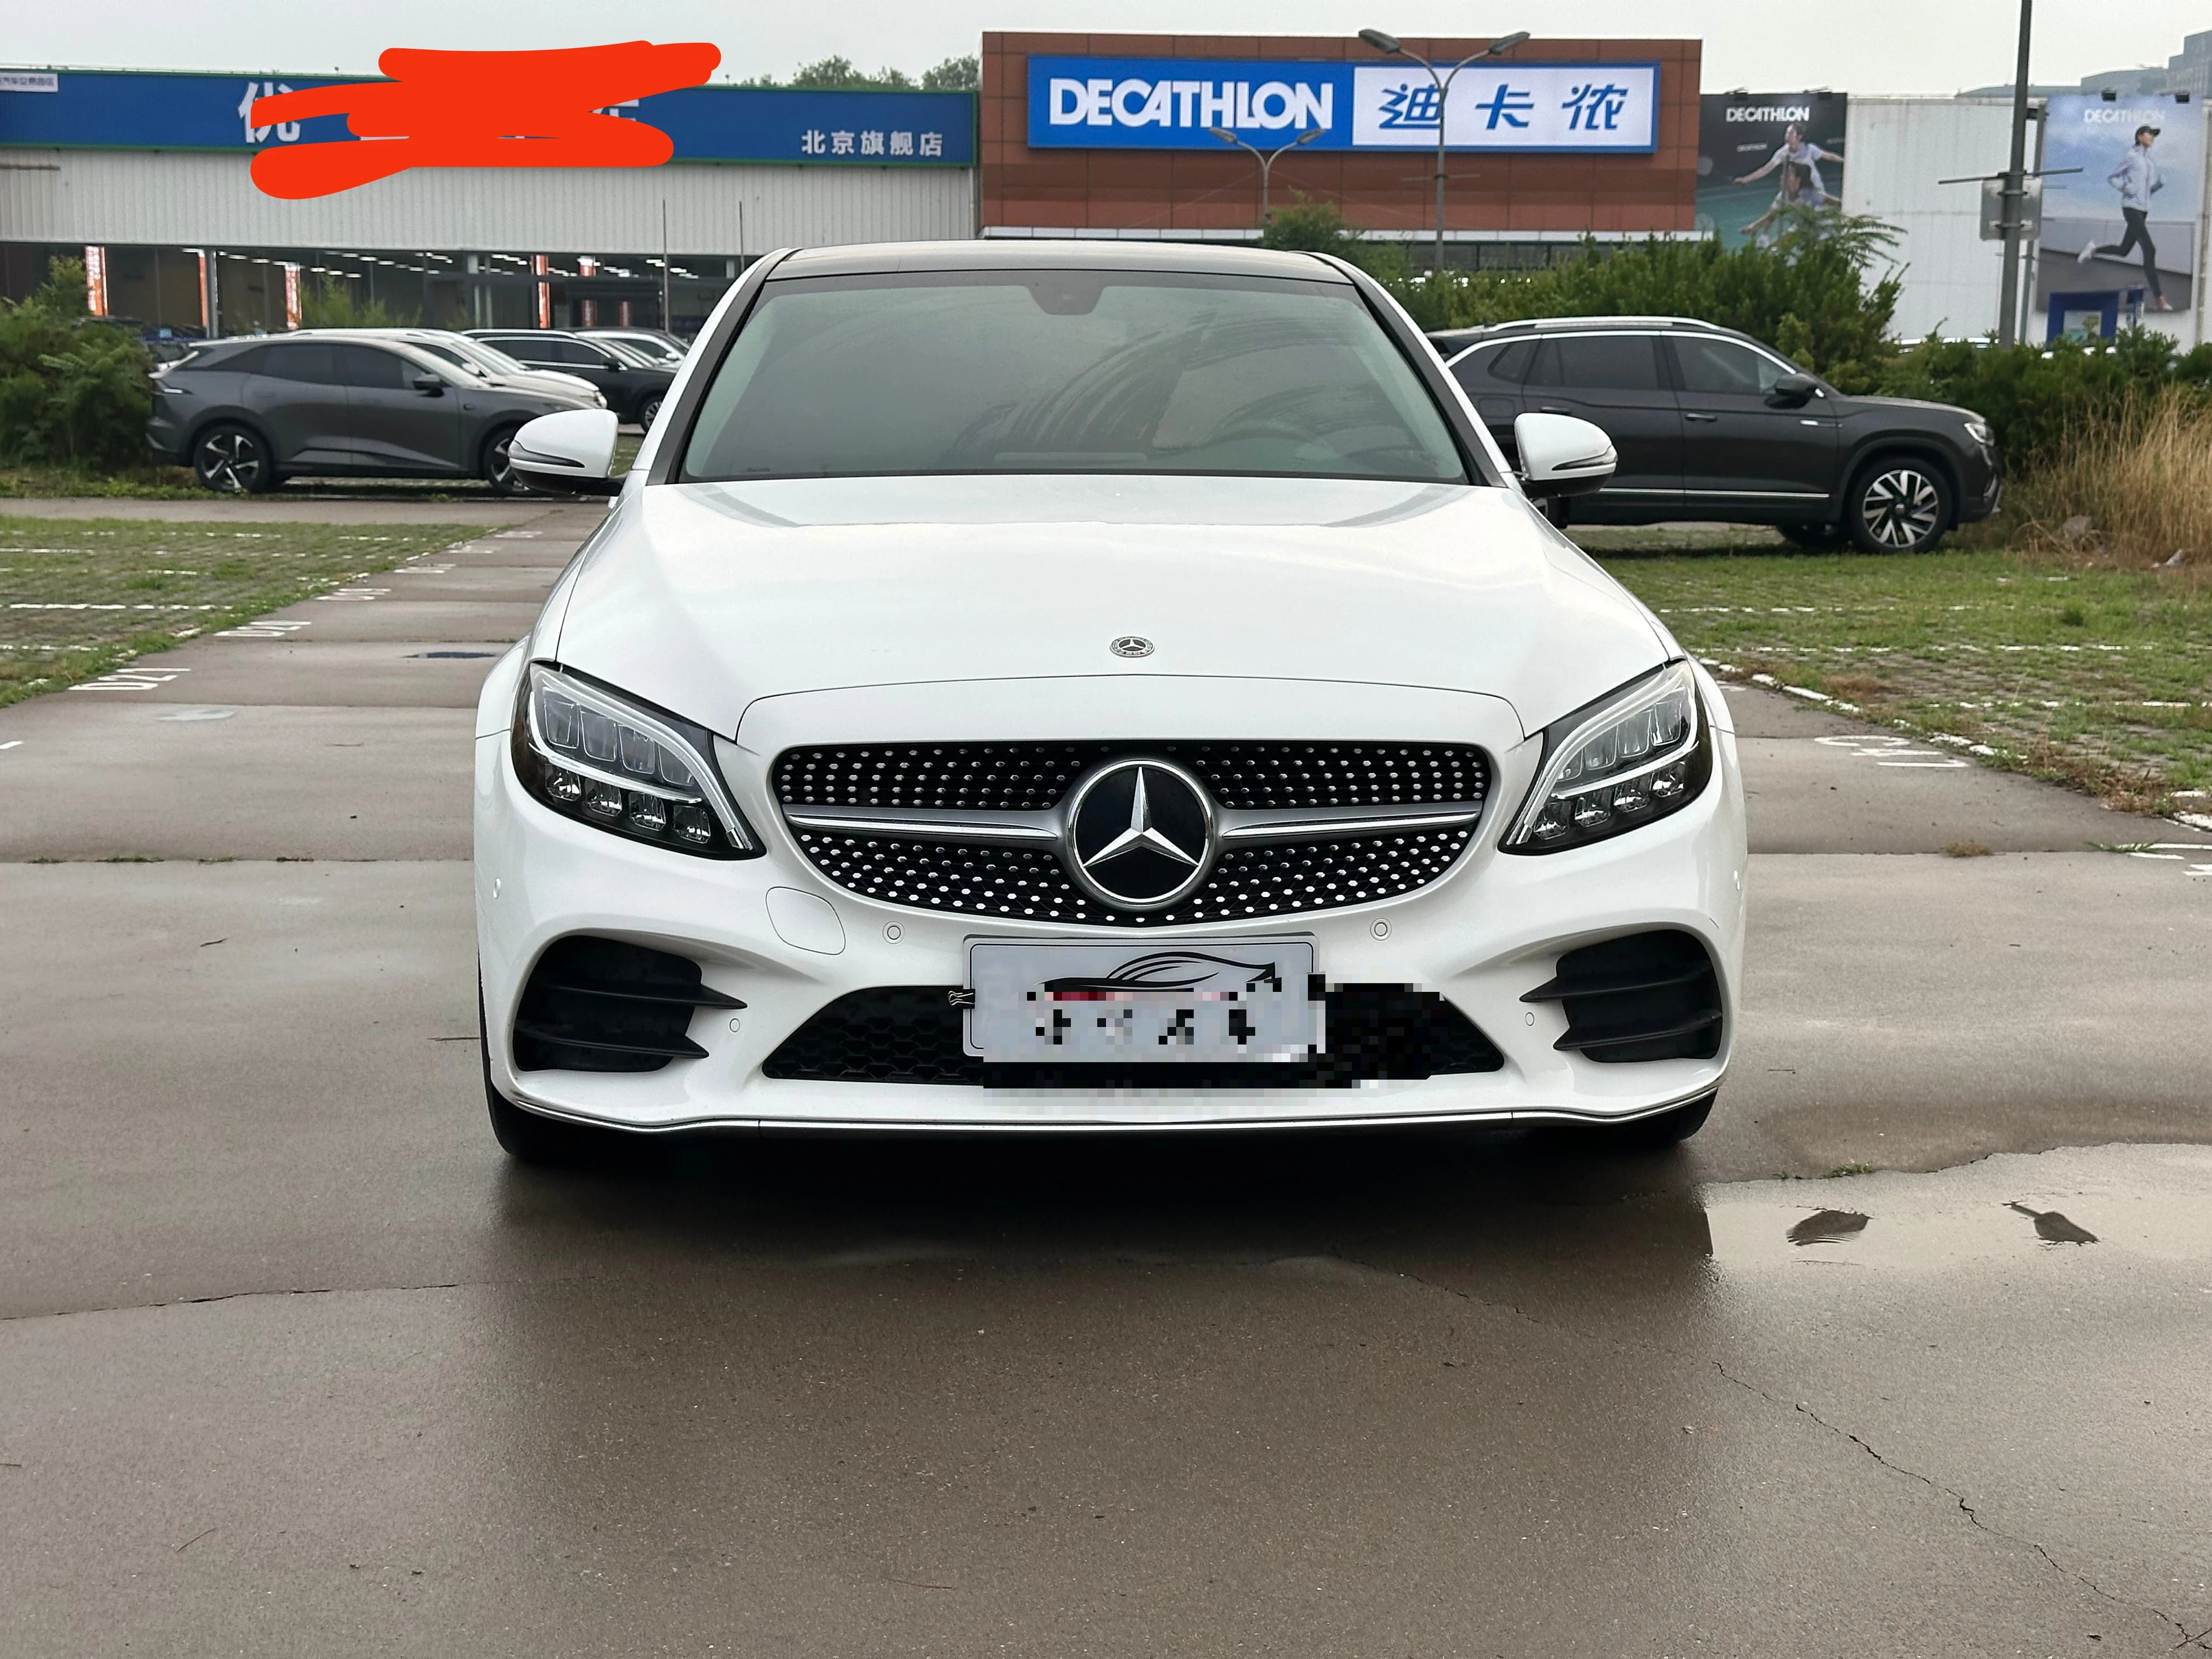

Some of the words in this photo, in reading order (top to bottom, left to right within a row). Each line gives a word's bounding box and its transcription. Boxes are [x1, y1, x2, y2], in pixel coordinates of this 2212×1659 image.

[1050, 78, 1334, 130] DECATHLON
[1378, 83, 1629, 130] 迪卡侬
[1726, 105, 1810, 122] DECATHLON
[801, 130, 943, 157] 北京旗舰店
